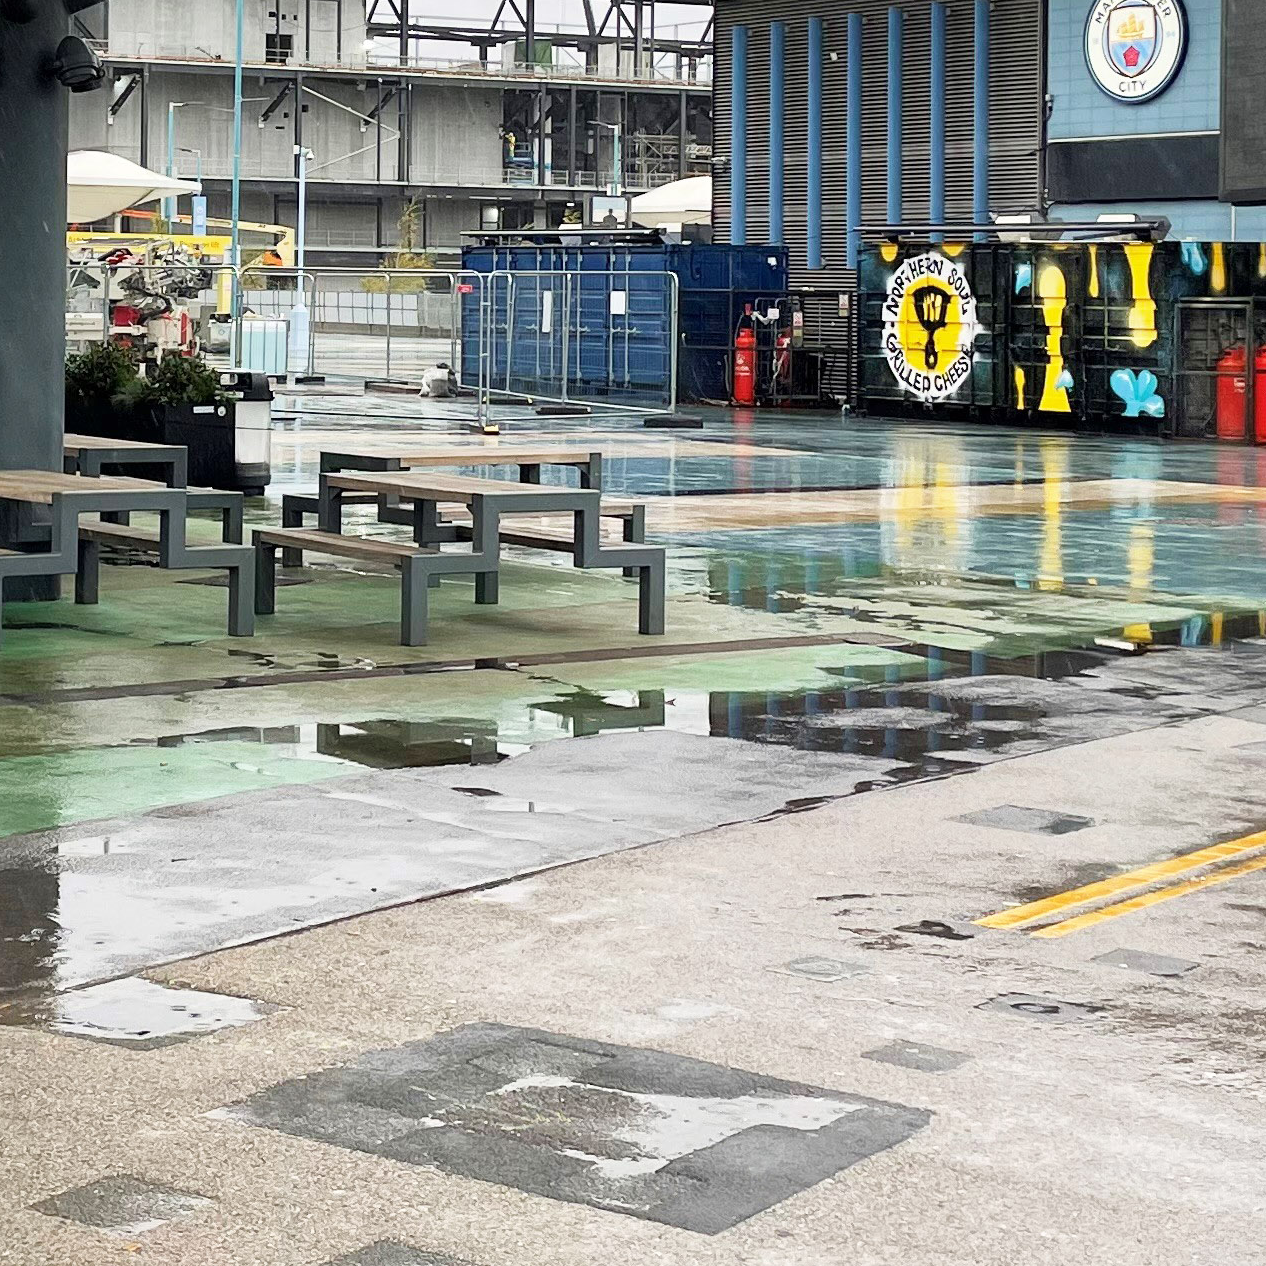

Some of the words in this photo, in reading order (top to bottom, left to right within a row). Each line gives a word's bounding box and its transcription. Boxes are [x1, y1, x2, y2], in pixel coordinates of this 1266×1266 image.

[1118, 80, 1146, 92] CITY
[886, 257, 944, 317] NORTHERN
[947, 268, 971, 316] SOUL
[886, 333, 931, 394] GRILLED
[934, 341, 974, 392] CHEESE
